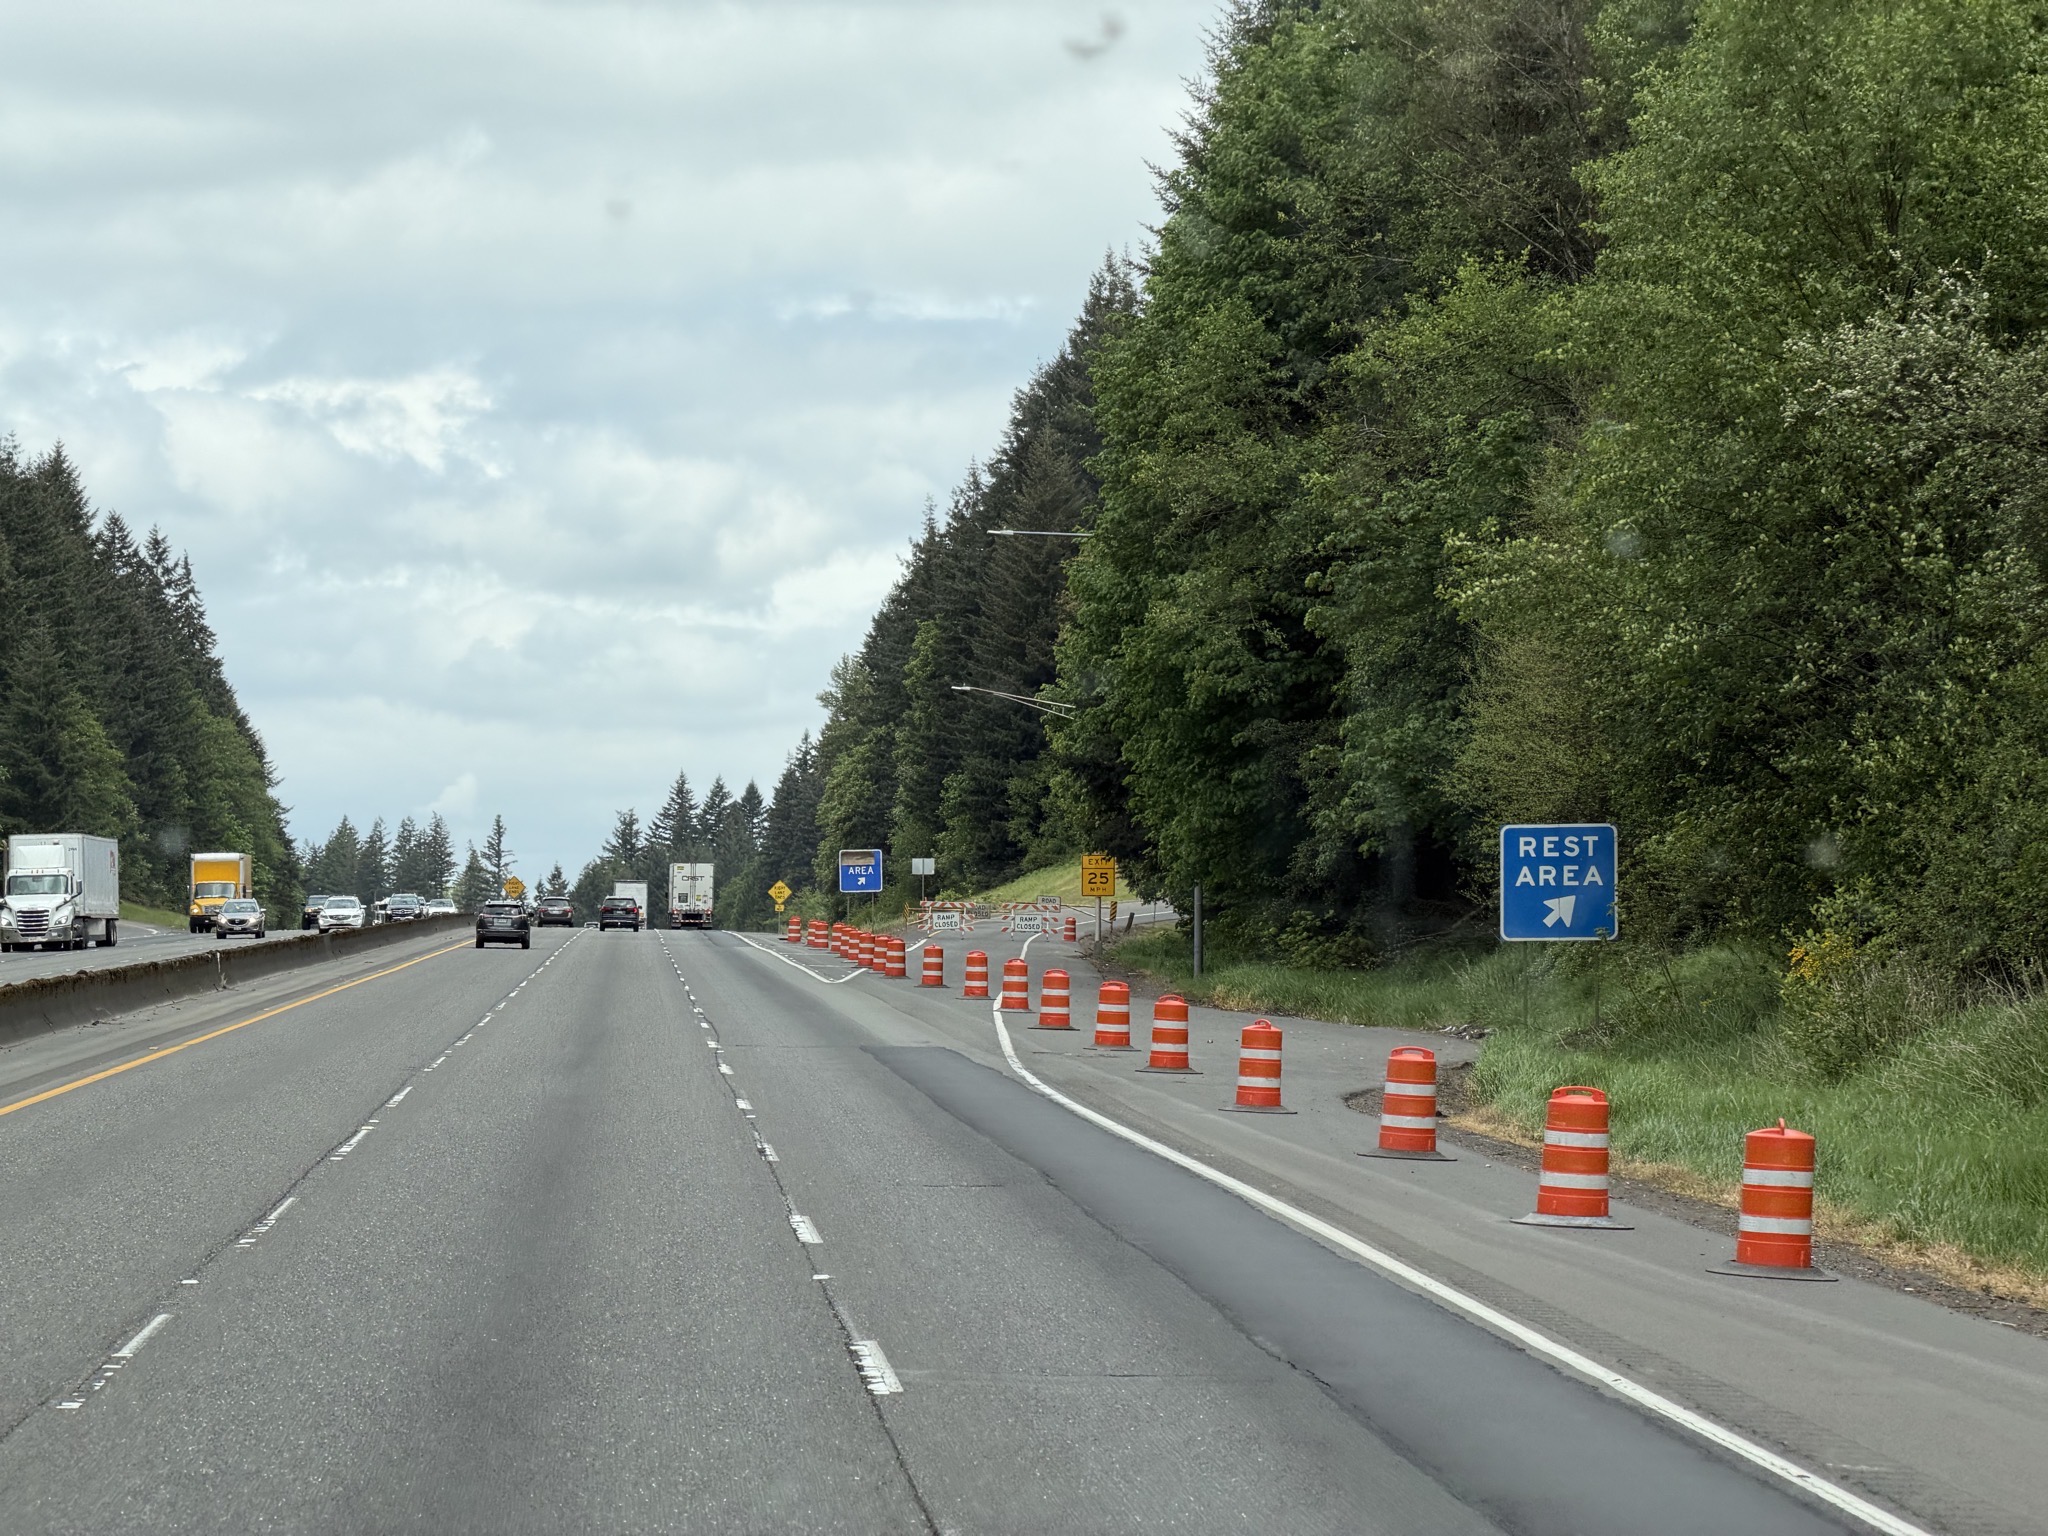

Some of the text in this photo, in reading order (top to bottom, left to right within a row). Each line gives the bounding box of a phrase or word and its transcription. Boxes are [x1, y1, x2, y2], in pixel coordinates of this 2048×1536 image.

[1519, 836, 1599, 857] REST
[848, 866, 874, 875] AREA
[1088, 872, 1109, 884] 25
[1515, 865, 1603, 886] AREA
